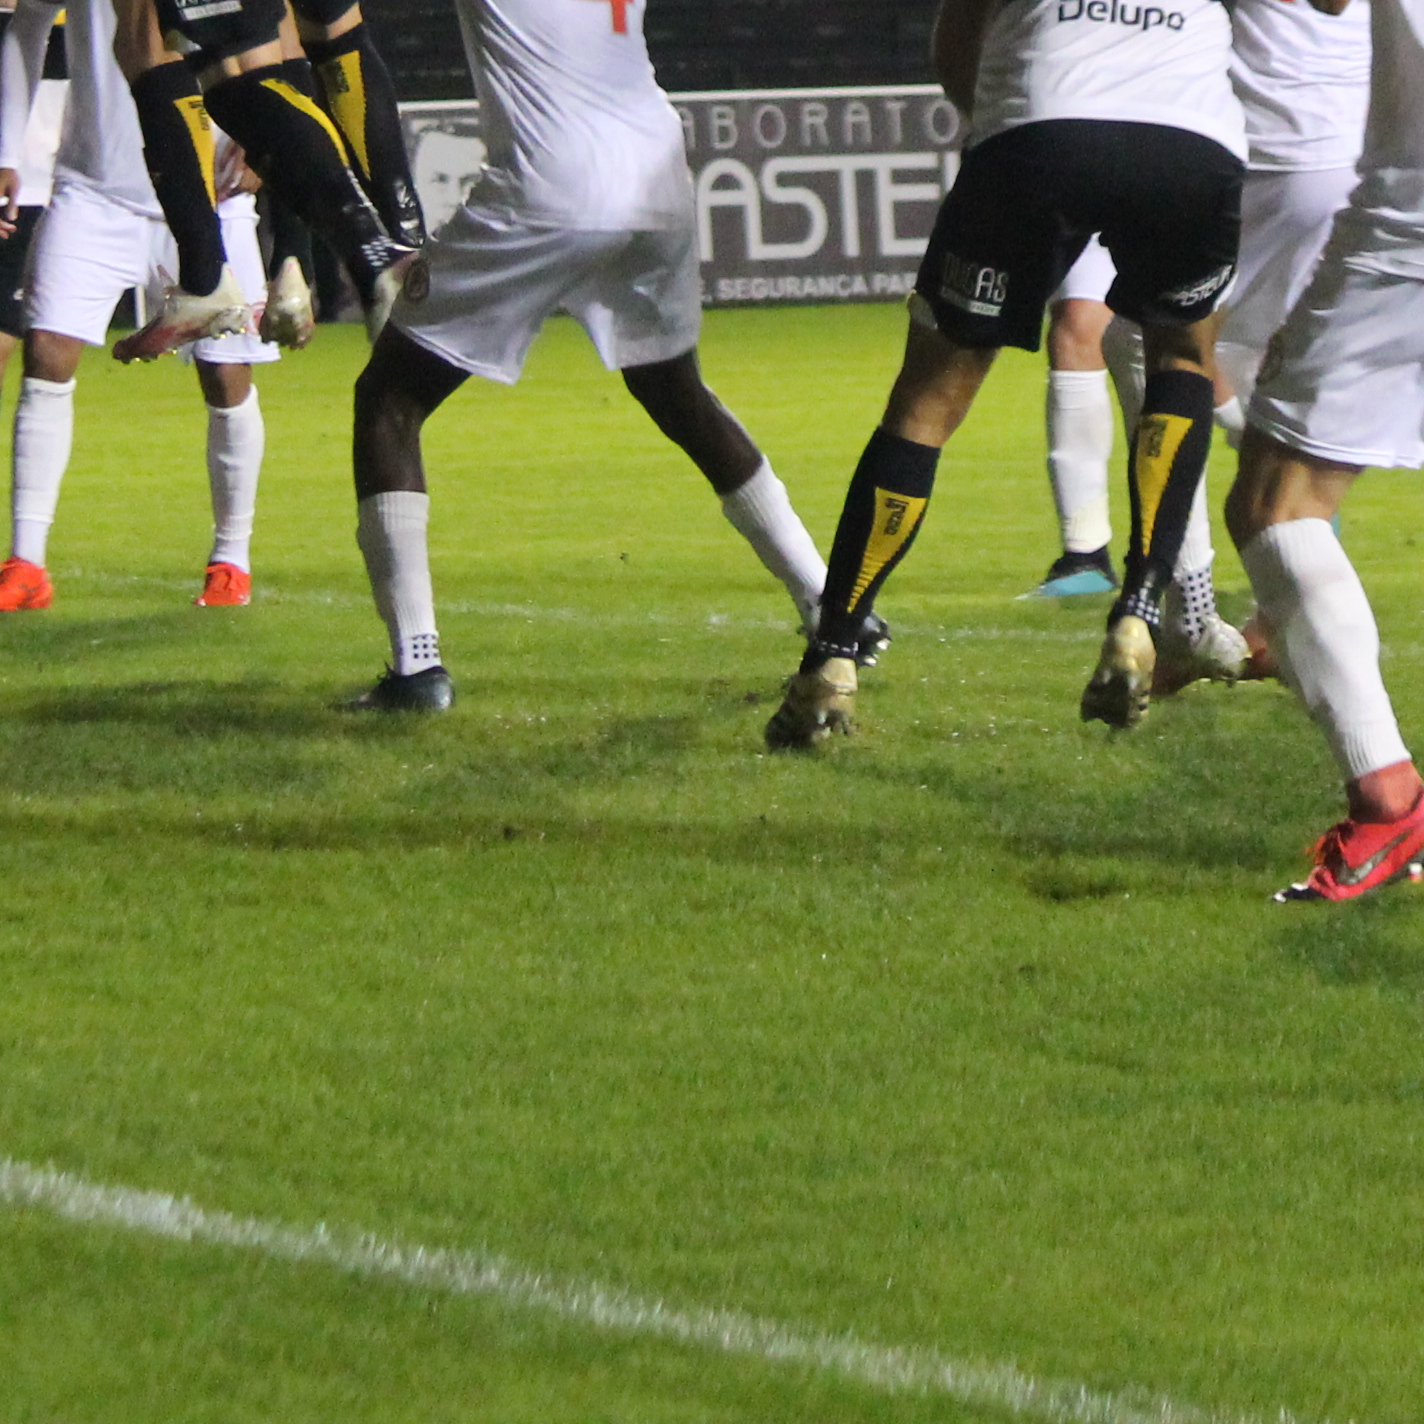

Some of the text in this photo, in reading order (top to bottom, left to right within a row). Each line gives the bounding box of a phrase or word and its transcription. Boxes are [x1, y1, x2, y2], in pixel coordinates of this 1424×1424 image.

[678, 98, 961, 151] ABORATO
[697, 150, 962, 263] ASTE
[718, 273, 869, 300] SEGURANÇA
